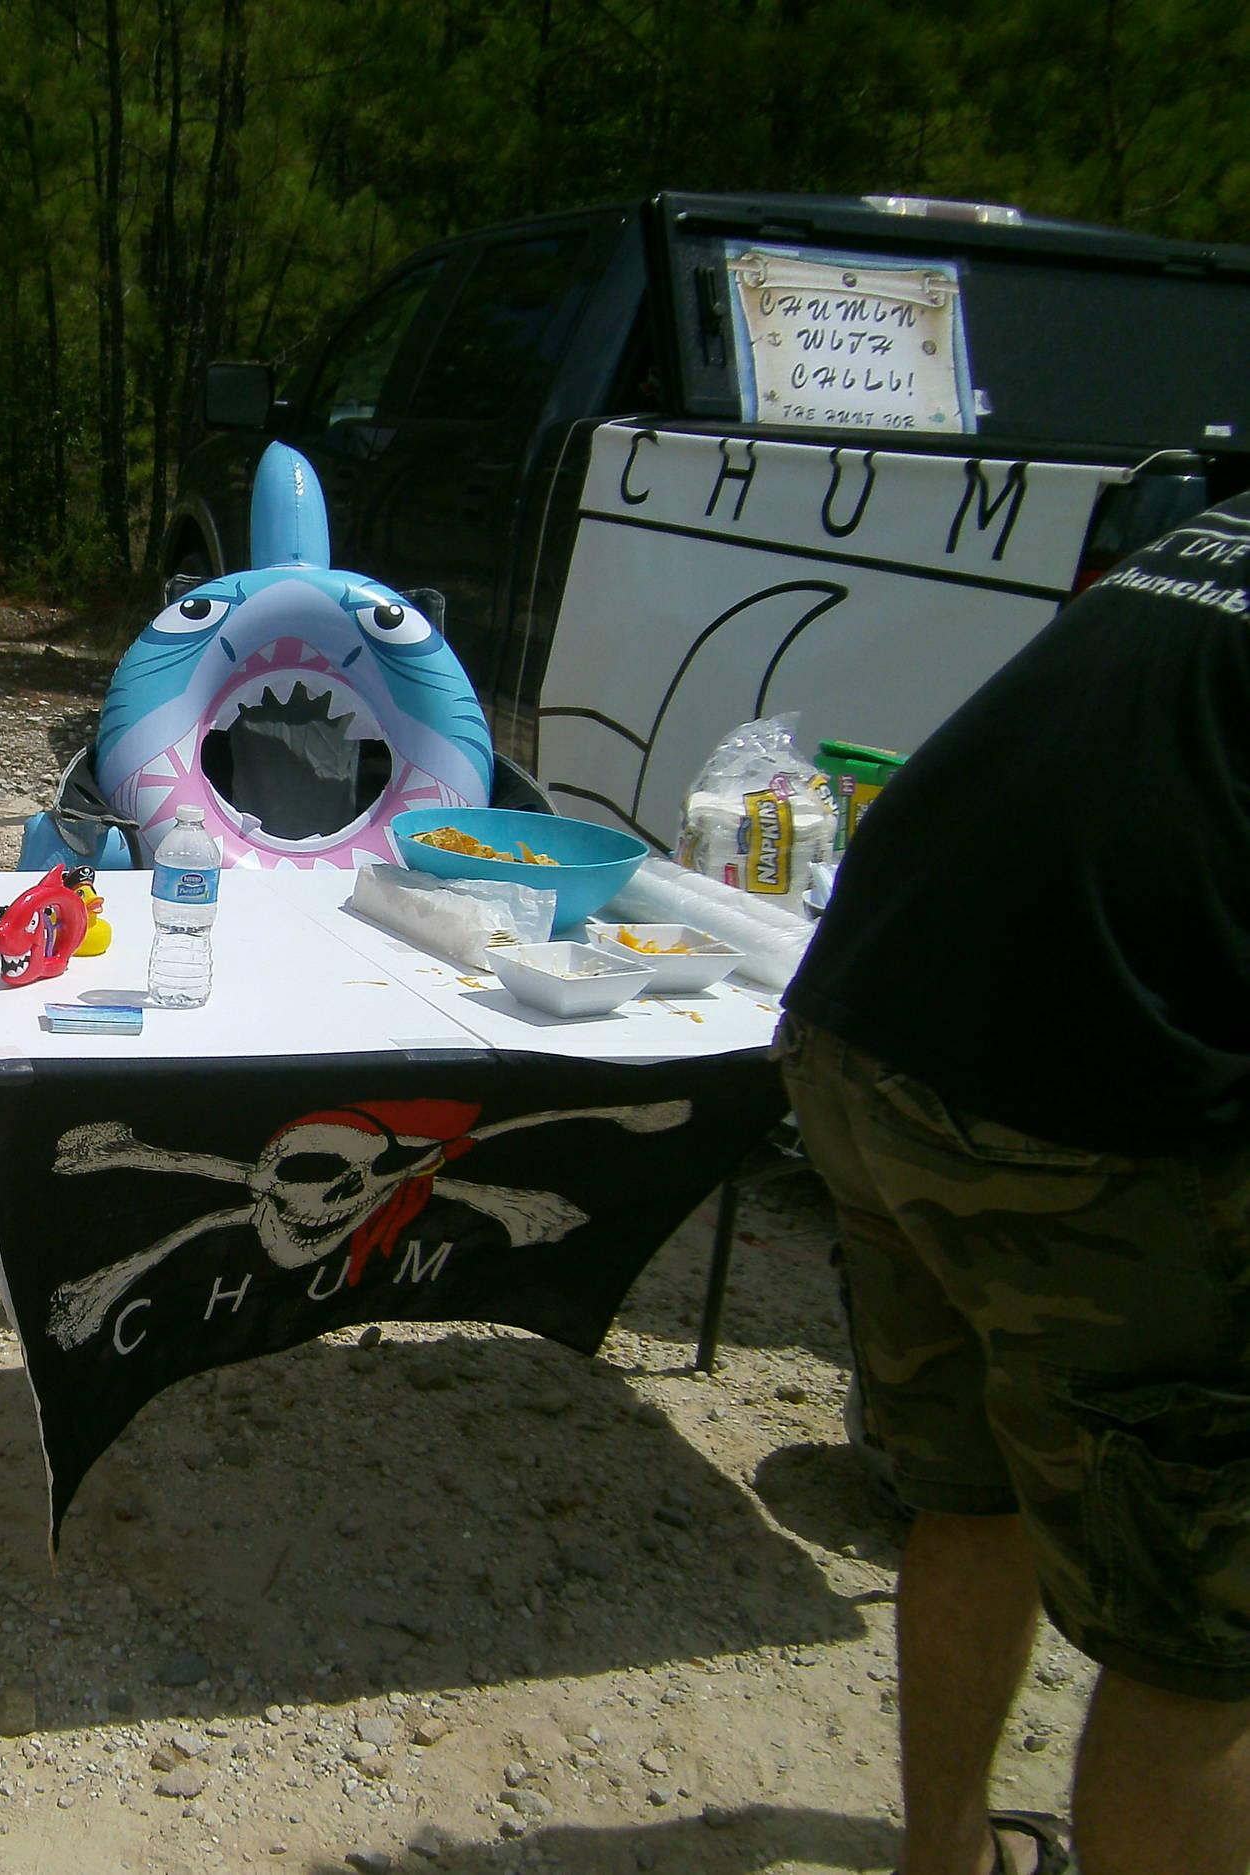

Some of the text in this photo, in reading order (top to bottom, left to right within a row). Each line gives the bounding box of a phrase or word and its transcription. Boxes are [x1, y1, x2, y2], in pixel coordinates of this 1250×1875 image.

[797, 328, 895, 356] WITH
[783, 404, 916, 429] THE HUNT FOR
[620, 429, 1029, 562] CHUM
[112, 1239, 453, 1355] CHUM
